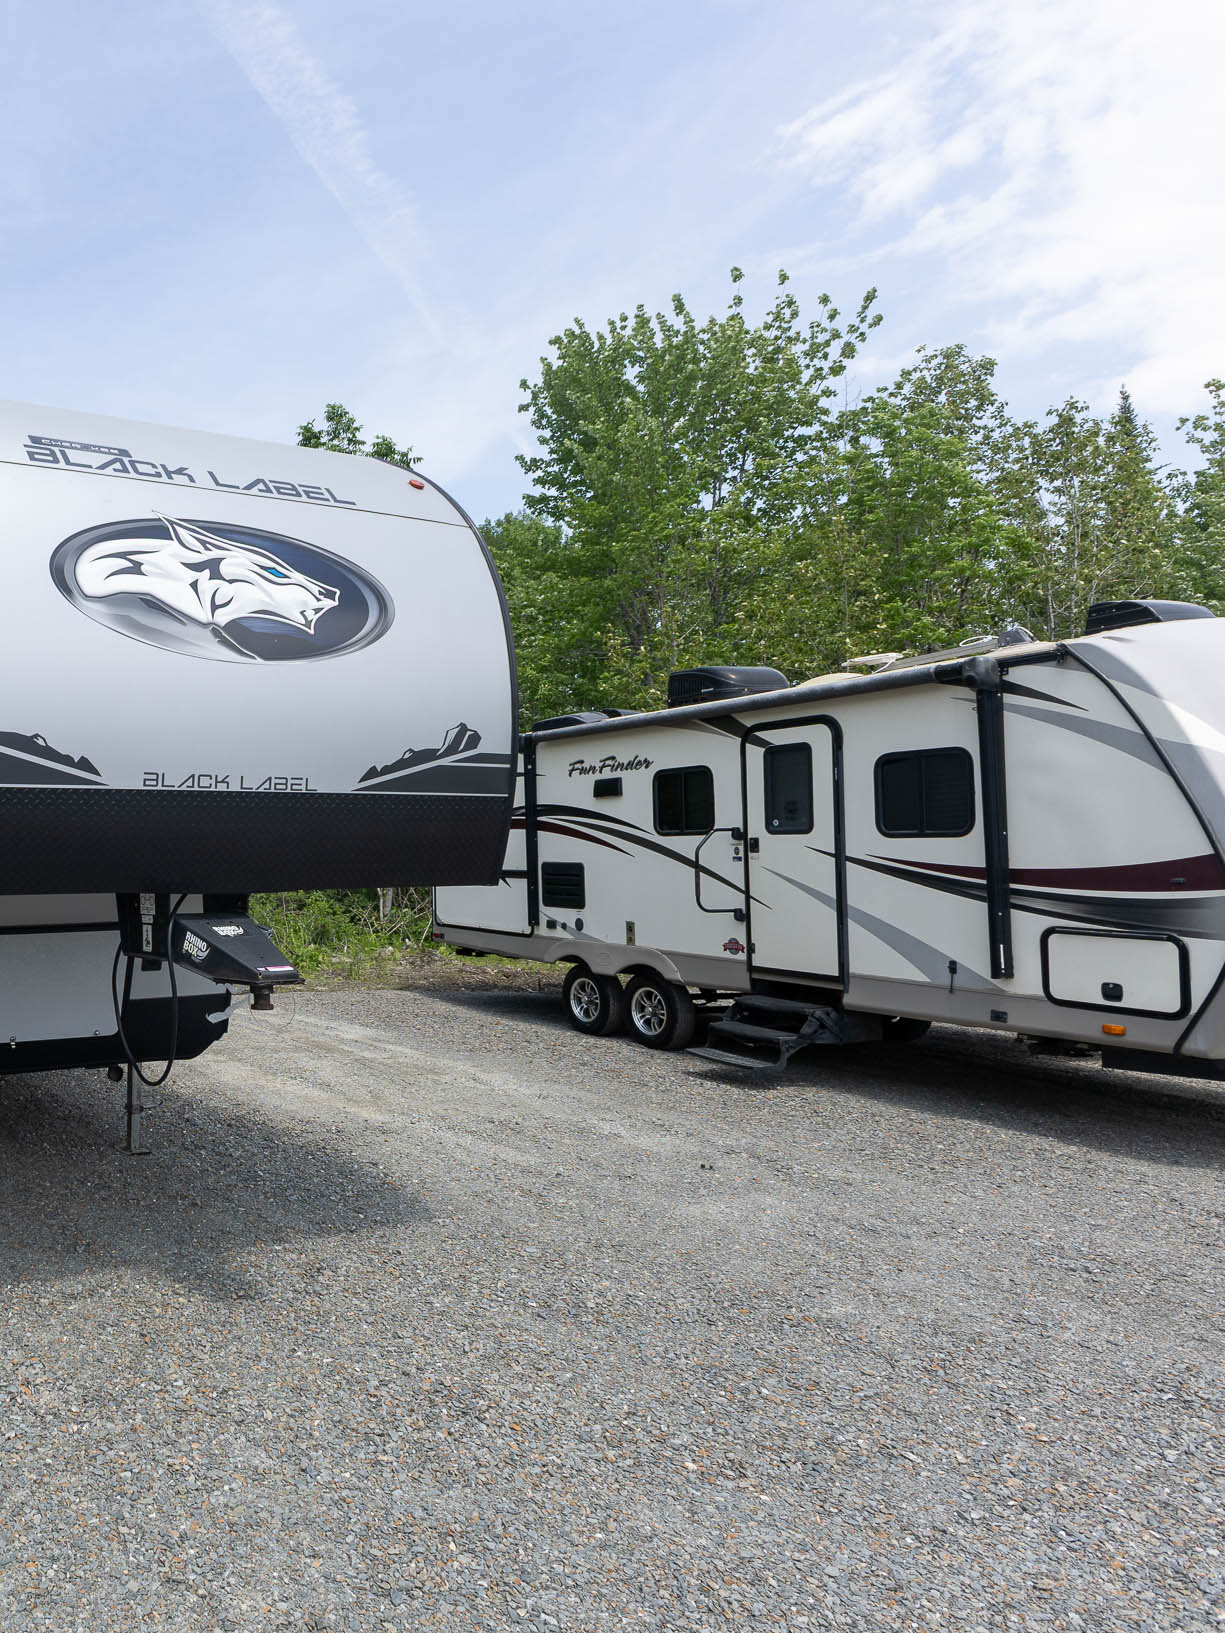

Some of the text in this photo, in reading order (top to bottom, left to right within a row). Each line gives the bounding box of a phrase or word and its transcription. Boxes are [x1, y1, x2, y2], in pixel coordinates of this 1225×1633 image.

[23, 444, 357, 505] BLACK LABEL
[143, 772, 318, 792] BLACK LABEL
[184, 940, 198, 957] BOX
[186, 931, 206, 951] RHINO
